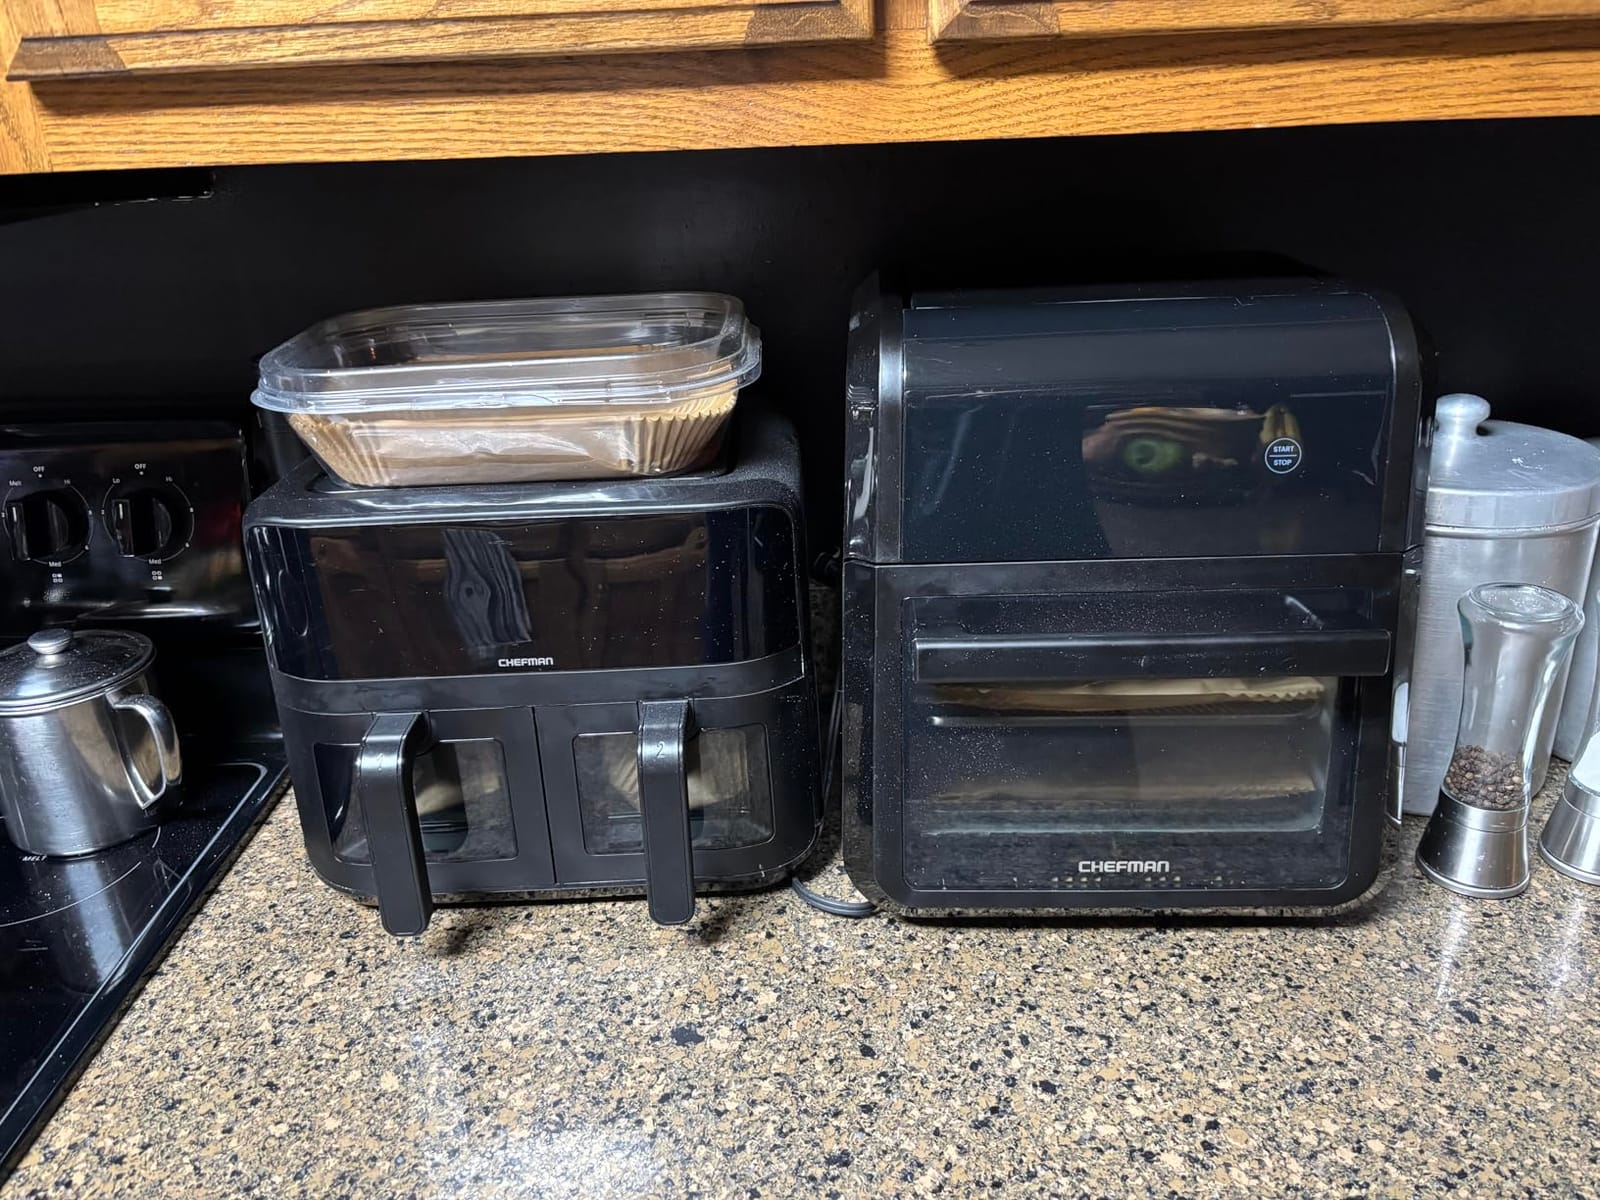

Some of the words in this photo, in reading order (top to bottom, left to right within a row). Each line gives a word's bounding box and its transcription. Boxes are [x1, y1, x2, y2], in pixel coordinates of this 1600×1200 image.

[1273, 445, 1294, 453] START
[498, 657, 554, 667] CHEFMAN
[656, 740, 666, 759] 2
[1078, 860, 1170, 873] CHEFMAN
